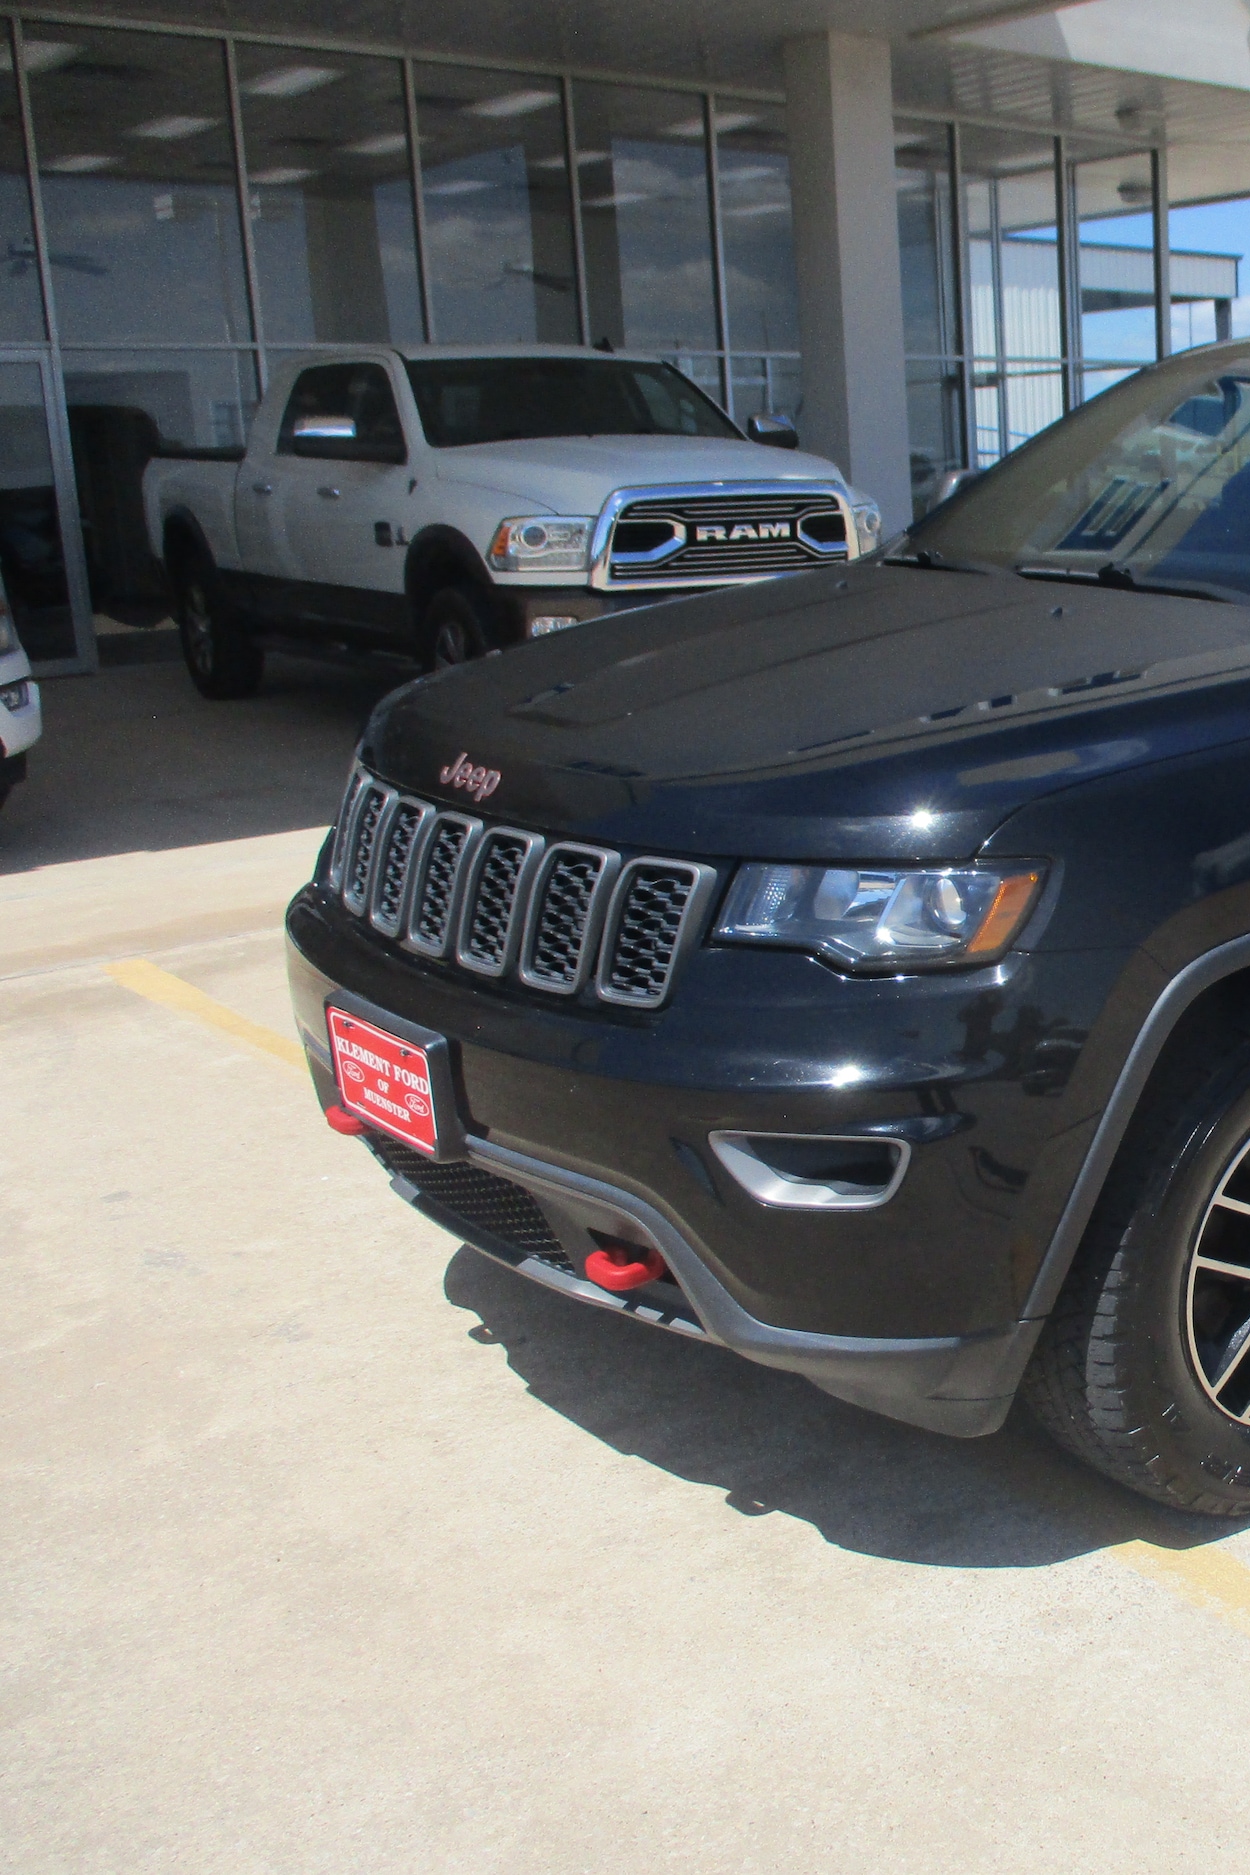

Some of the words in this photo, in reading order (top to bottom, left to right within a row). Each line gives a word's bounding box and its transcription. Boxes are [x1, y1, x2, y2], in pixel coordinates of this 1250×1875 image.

[696, 522, 790, 541] RAM
[440, 752, 501, 801] Jeep
[336, 1036, 391, 1077] KLEMENT
[394, 1064, 429, 1095] FORD
[377, 1078, 390, 1093] OF
[363, 1087, 412, 1122] MUENSTER
[408, 1095, 425, 1115] Ford
